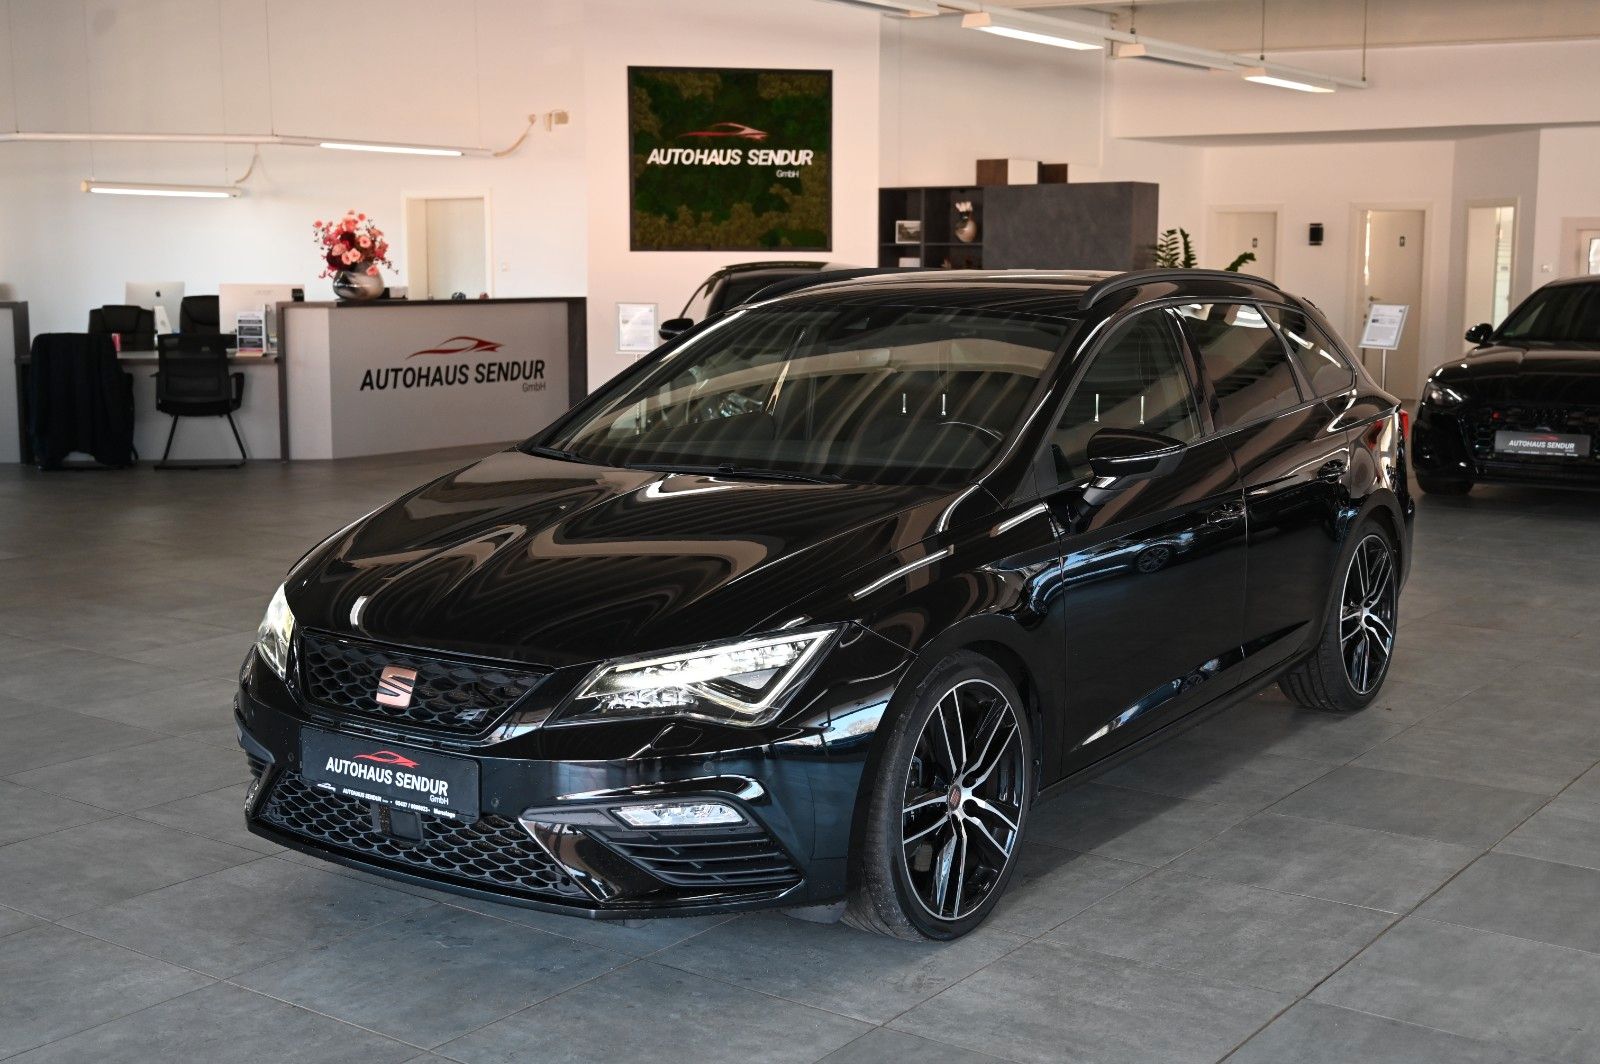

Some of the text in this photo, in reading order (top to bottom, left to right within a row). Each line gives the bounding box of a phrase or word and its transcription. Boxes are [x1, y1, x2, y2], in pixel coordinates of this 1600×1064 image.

[647, 148, 814, 166] AUTOHAUS SENDUR
[776, 169, 799, 178] GmbH
[360, 359, 546, 391] AUTOHAUS SENDUR
[522, 382, 546, 393] GmbH
[1509, 440, 1546, 448] AUTOHAUS
[325, 757, 449, 796] AUTOHAUS SENDUR
[429, 795, 449, 805] GmbH
